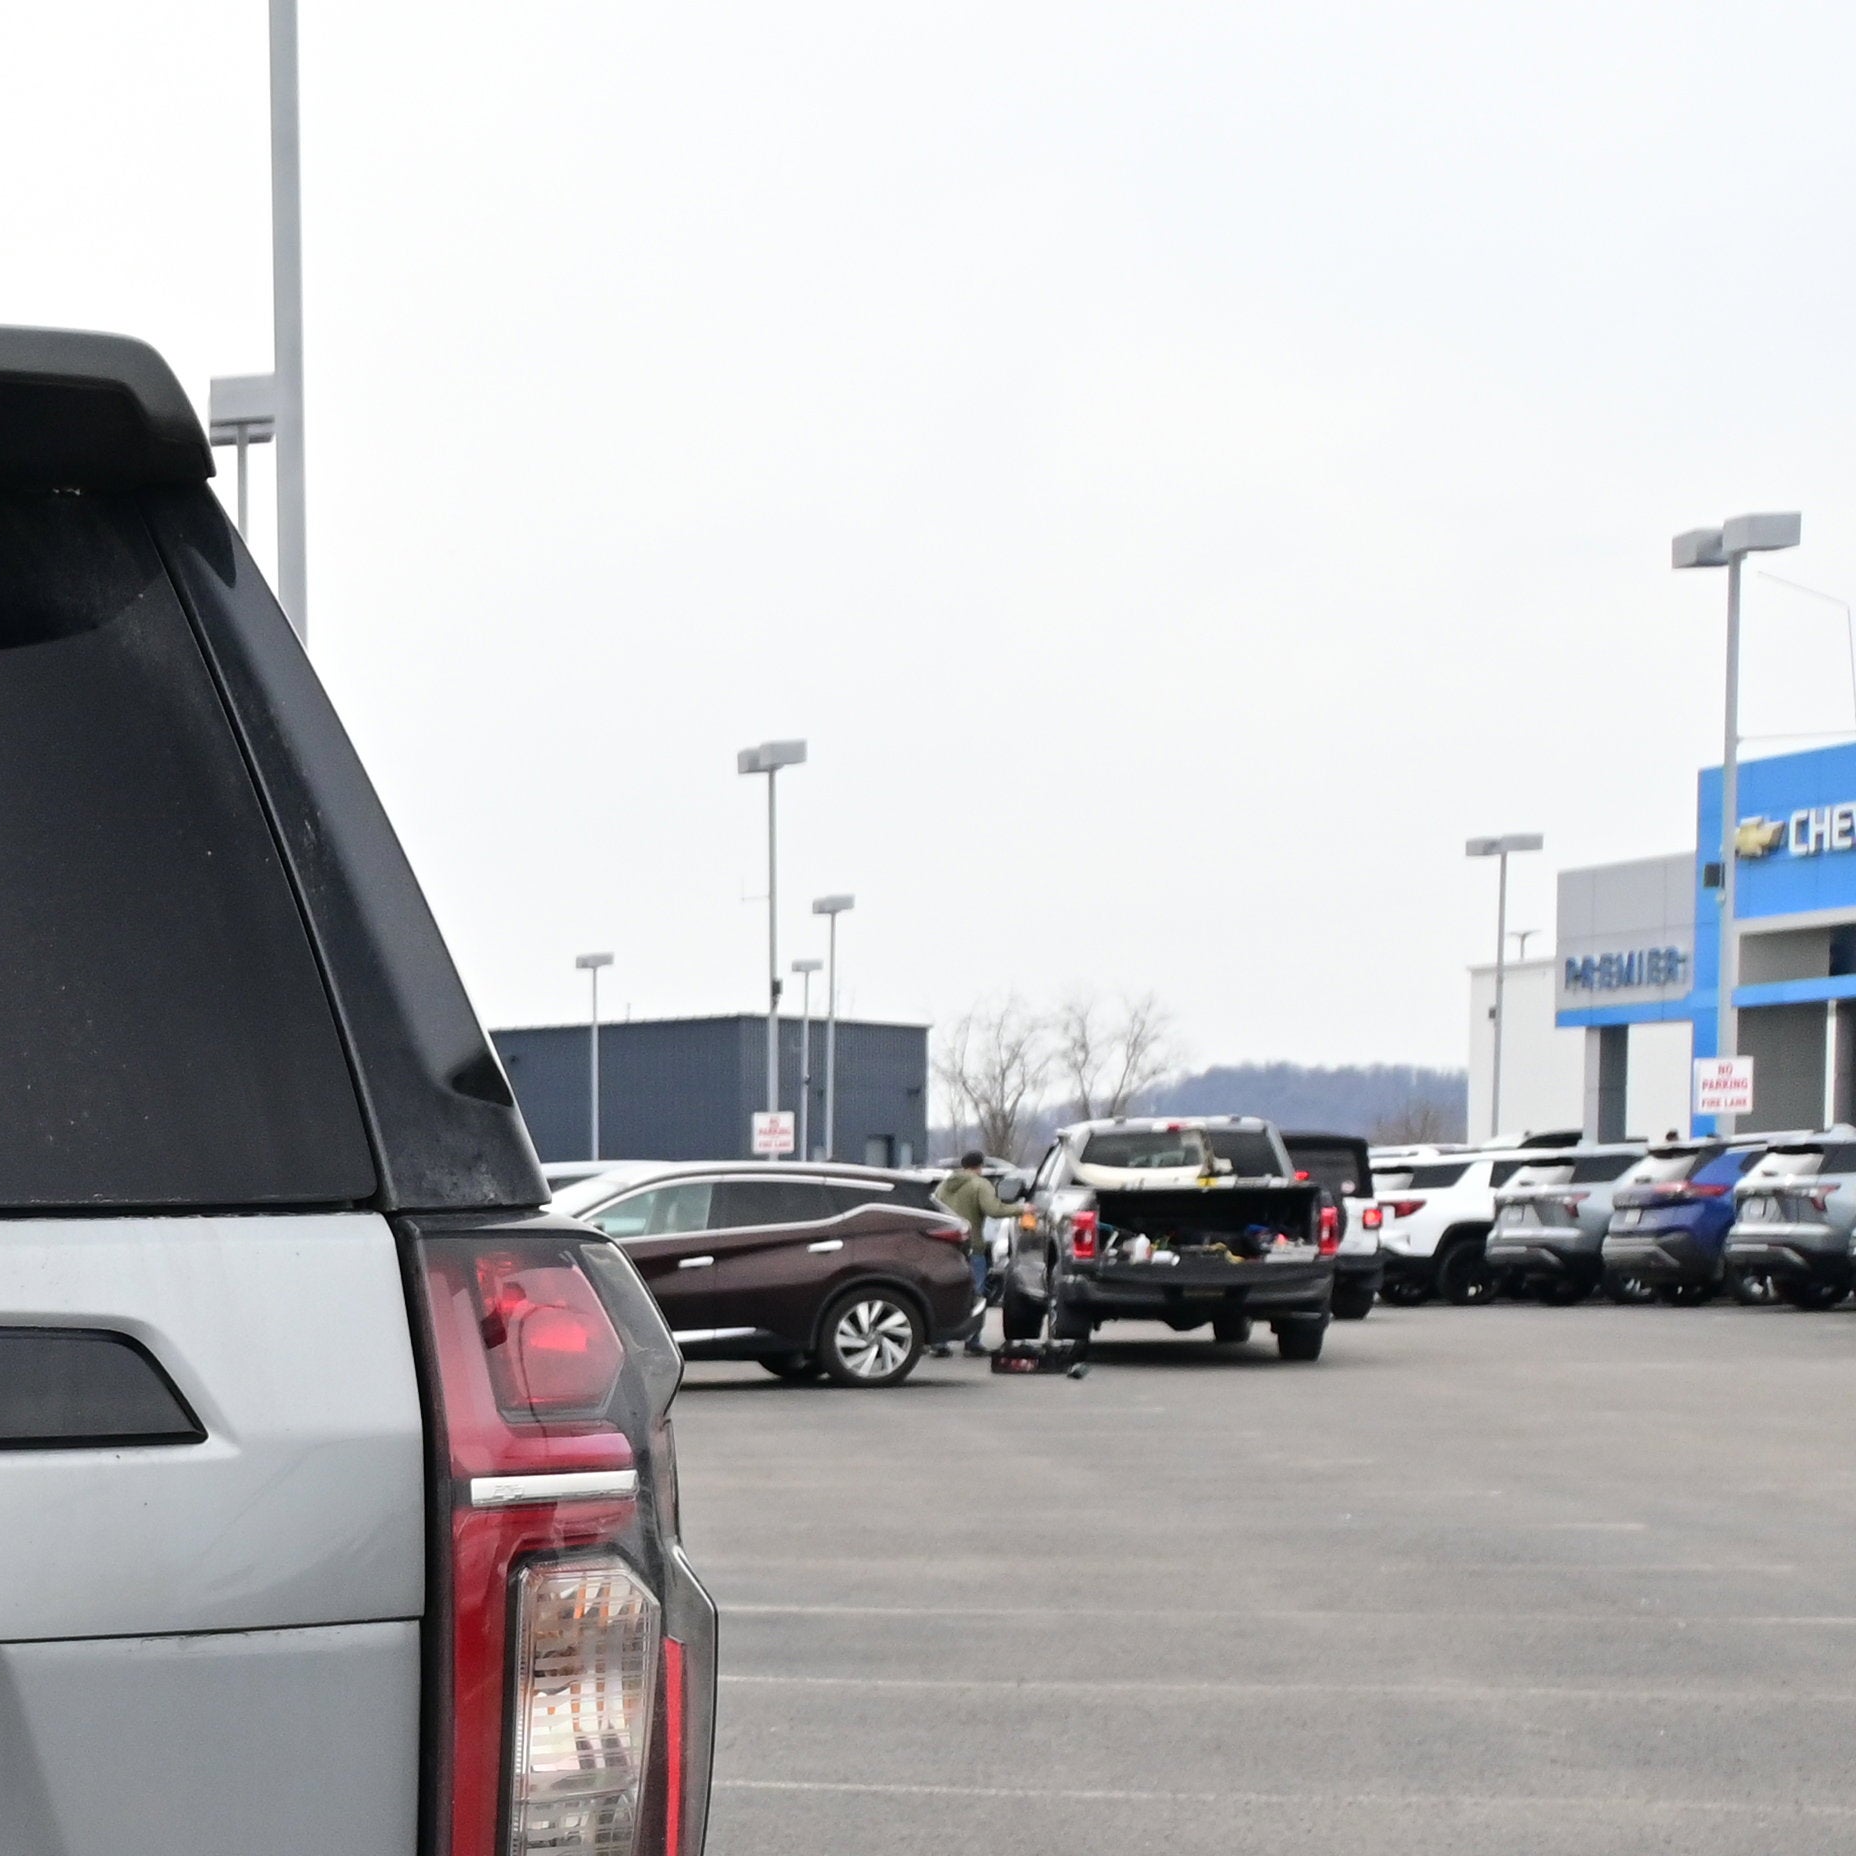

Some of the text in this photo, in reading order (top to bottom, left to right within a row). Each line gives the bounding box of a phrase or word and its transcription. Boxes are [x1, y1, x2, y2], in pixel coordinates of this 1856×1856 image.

[1789, 802, 1856, 855] CHE
[1718, 1063, 1733, 1075] NO
[1702, 1078, 1748, 1090] PARKING
[1701, 1097, 1720, 1107] FIRE
